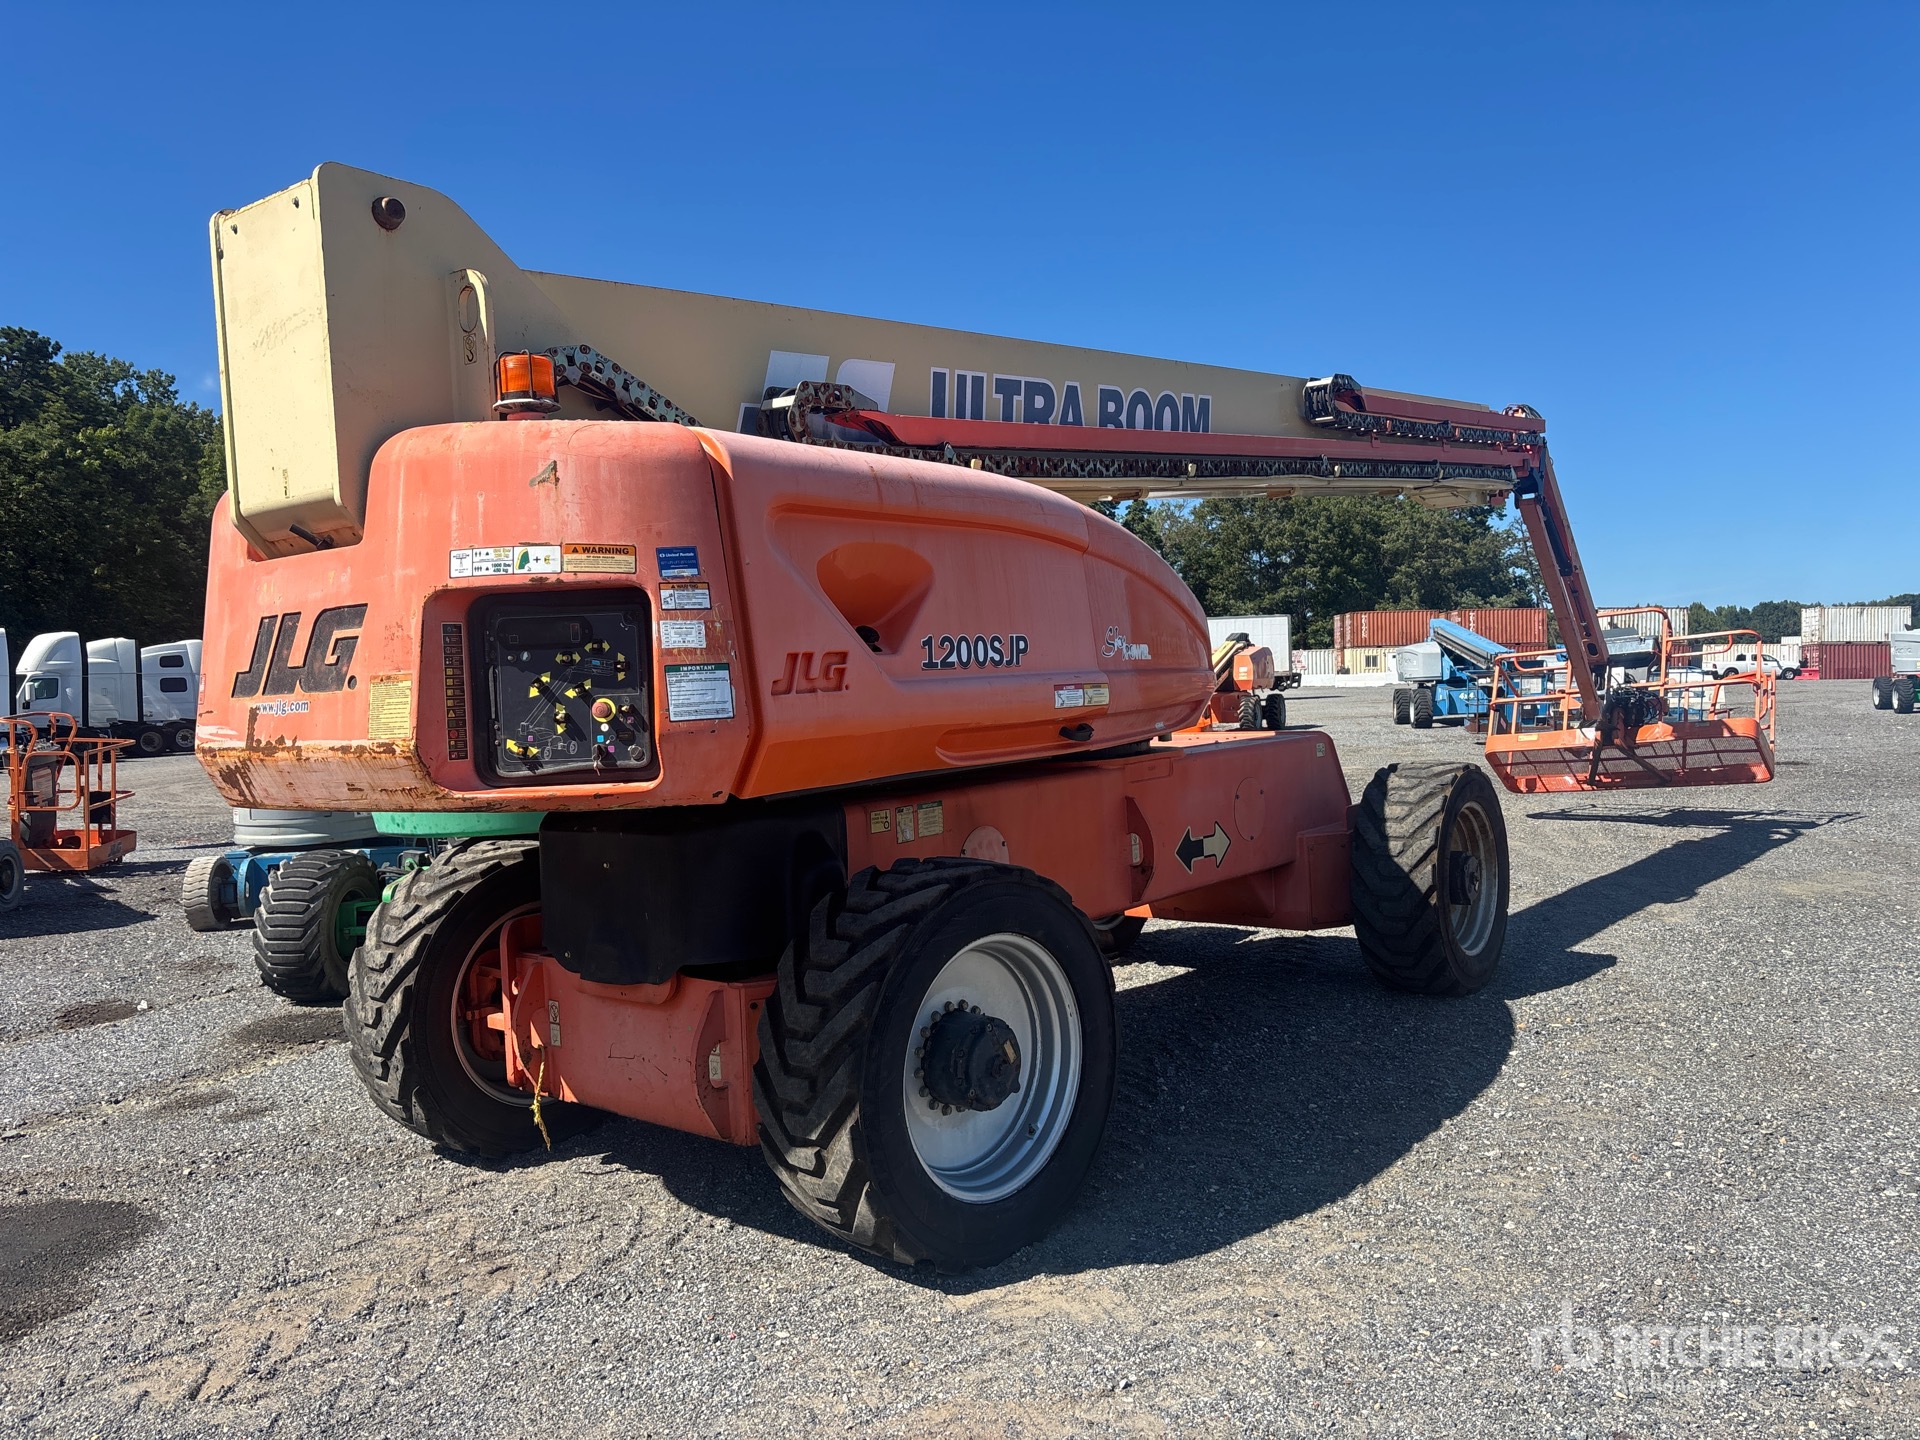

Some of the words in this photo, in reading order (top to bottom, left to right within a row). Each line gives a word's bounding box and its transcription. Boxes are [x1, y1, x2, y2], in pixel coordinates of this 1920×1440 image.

[1097, 384, 1212, 434] BOOM
[582, 546, 629, 555] WARNING
[920, 633, 1029, 670] 1200SJP
[256, 699, 310, 715] www.jlg.com
